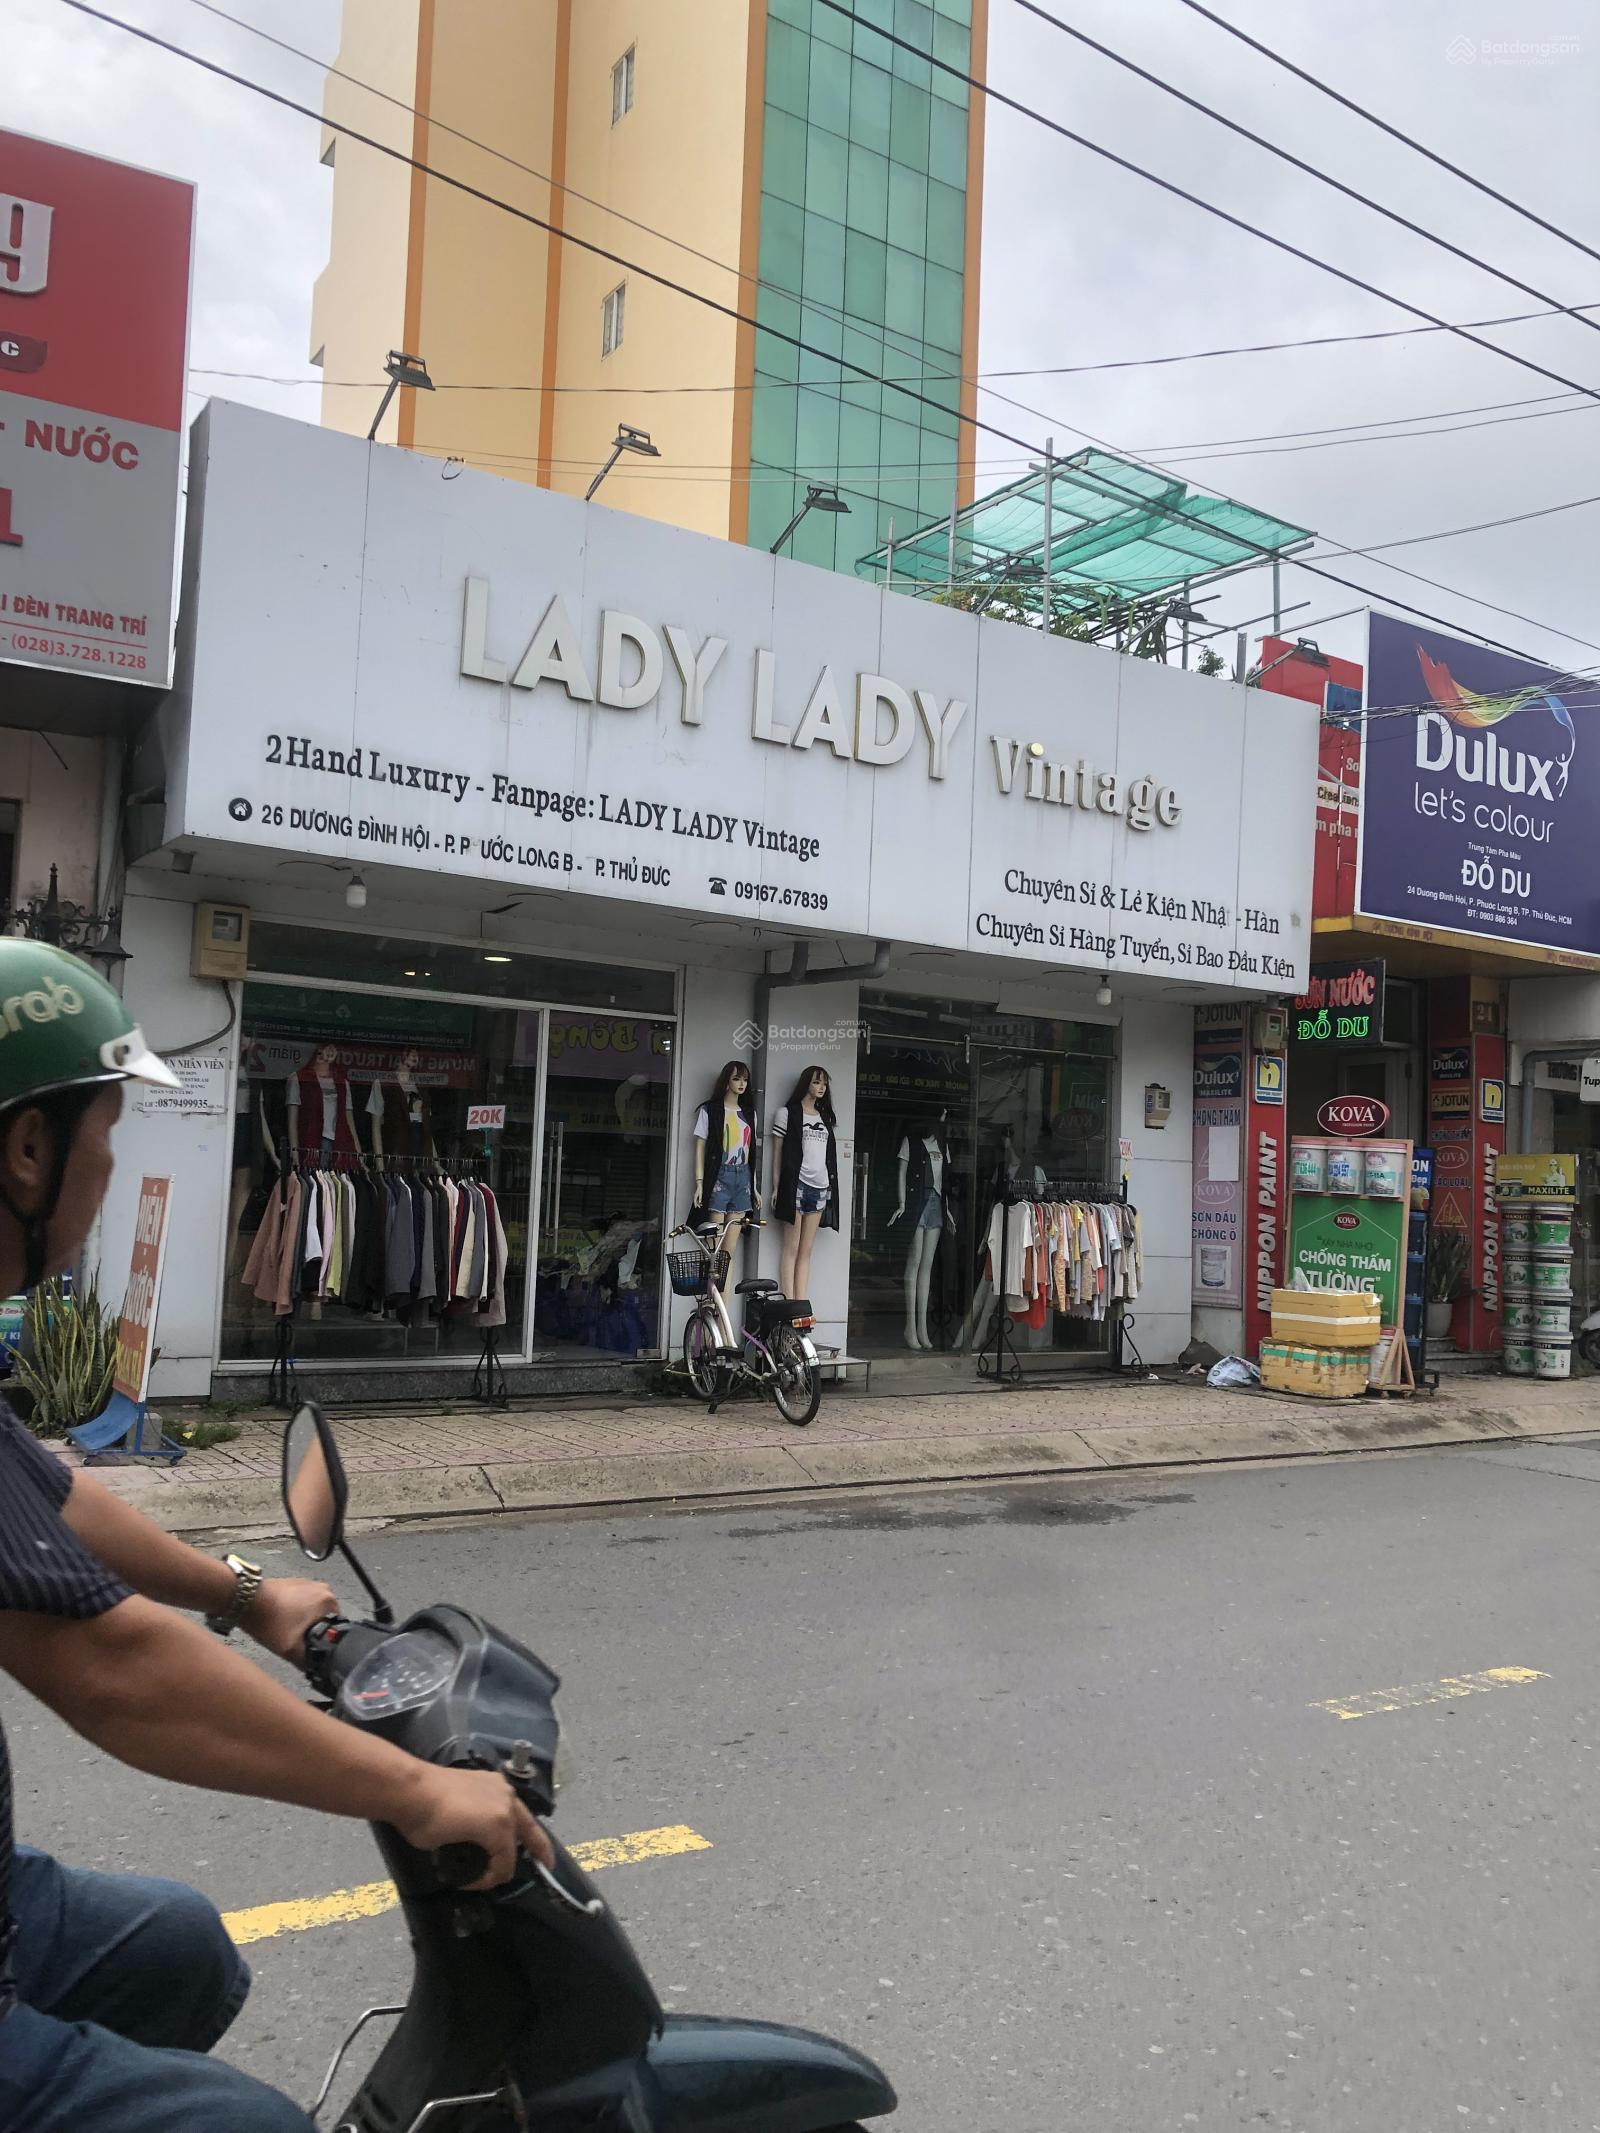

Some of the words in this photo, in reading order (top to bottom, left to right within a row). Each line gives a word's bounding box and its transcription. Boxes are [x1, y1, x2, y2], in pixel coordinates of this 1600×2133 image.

[24, 416, 139, 470] NƯỚC
[13, 595, 49, 618] ĐÈN
[55, 604, 114, 631] TRANG
[119, 615, 147, 636] TRÍ
[11, 633, 147, 670] (028)3.728.1228
[460, 575, 728, 727] LADY
[752, 648, 968, 781] LADY
[1415, 712, 1555, 801] Dulux
[265, 734, 363, 779] 2Hand
[368, 750, 470, 803] Luxury
[492, 773, 594, 823] Fanpage:
[599, 793, 668, 831] LADY
[672, 807, 738, 844] LADY
[743, 819, 821, 863] Vintage
[989, 735, 1183, 832] Vintage
[261, 804, 283, 826] 26
[358, 815, 398, 845] ĐÌNH
[402, 824, 430, 853] HỘI
[517, 844, 559, 870] LONG
[563, 853, 573, 872] B
[595, 858, 605, 877] P.
[609, 856, 638, 882] THỦ
[1474, 804, 1554, 843] colour
[1468, 842, 1485, 854] Trung
[734, 880, 828, 911] 09167.67839
[1461, 855, 1495, 890] ĐỖ
[1501, 868, 1531, 898] DU
[1004, 869, 1076, 905] Chuyên
[1100, 885, 1115, 909] &
[1120, 888, 1142, 913] Lẻ
[1146, 892, 1187, 920] Kiện
[1244, 908, 1280, 935] Hàn
[1407, 885, 1416, 895] 24
[1497, 903, 1513, 915] Long
[1558, 915, 1573, 925] HCM
[1479, 911, 1494, 922] 0903
[976, 913, 1044, 948] Chuyên
[1070, 927, 1116, 959] Hàng
[1120, 934, 1175, 965] Tuyển,
[1196, 946, 1223, 969] Bao
[1228, 946, 1258, 974] Đầu
[1261, 956, 1296, 981] Kiện
[1297, 1009, 1331, 1040] ĐỖ
[1336, 1016, 1370, 1038] DU
[1193, 1070, 1234, 1085] Dulux
[1432, 1059, 1465, 1071] Dulux
[469, 1109, 502, 1125] 20K
[1328, 1106, 1375, 1122] KOVA
[1258, 1131, 1278, 1208] PAINT
[1483, 1142, 1499, 1214] PAINT
[1527, 1186, 1570, 1195] MAXILITE
[1336, 1216, 1357, 1225] KOVA
[1299, 1248, 1346, 1267] CHỐNG
[1350, 1252, 1392, 1272] THẤM
